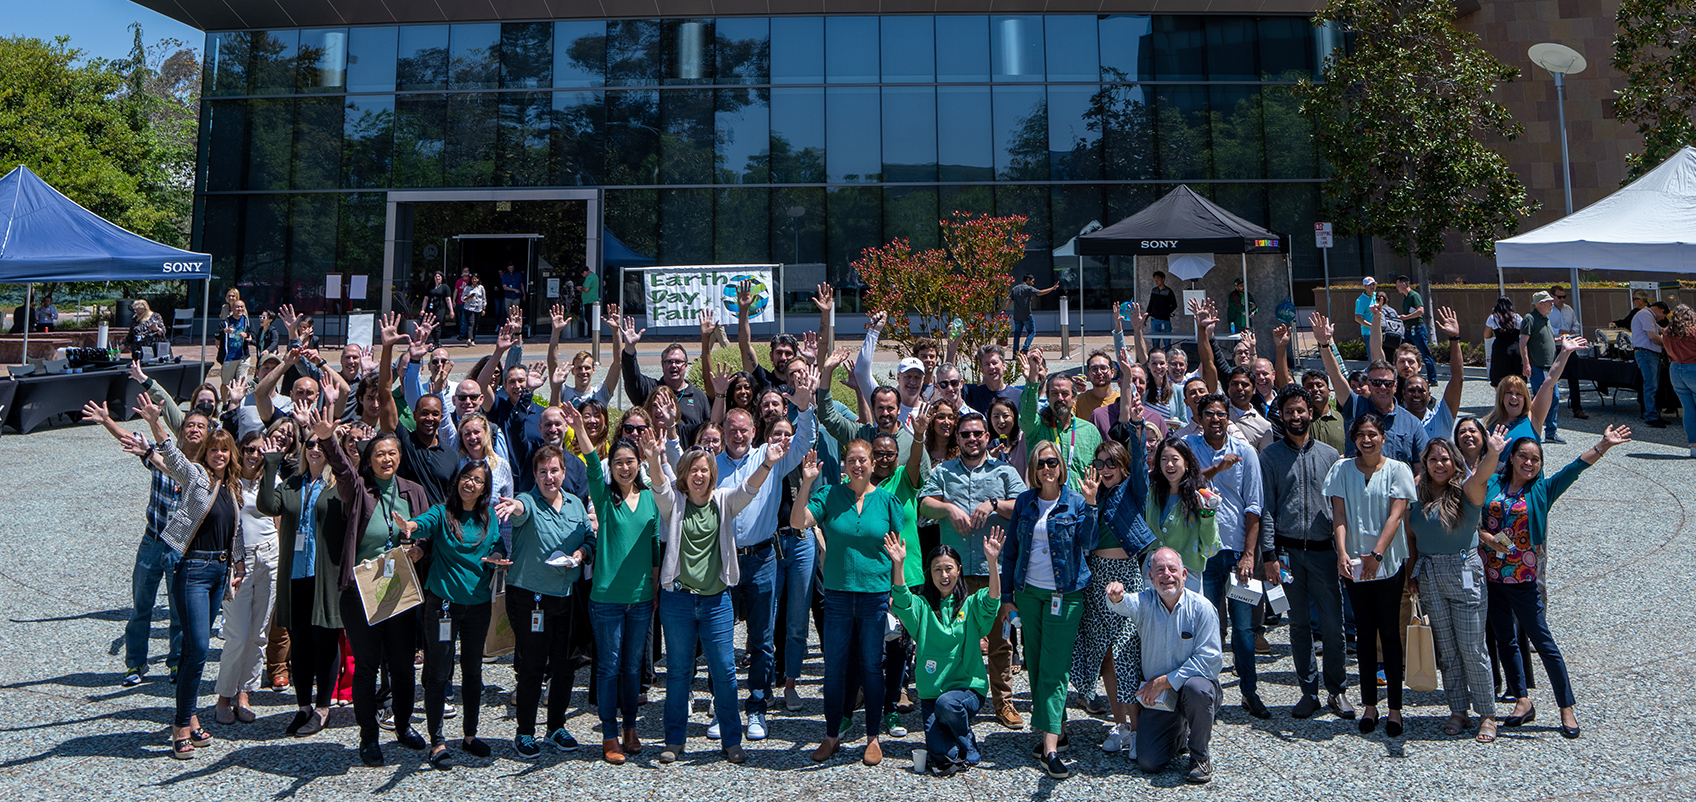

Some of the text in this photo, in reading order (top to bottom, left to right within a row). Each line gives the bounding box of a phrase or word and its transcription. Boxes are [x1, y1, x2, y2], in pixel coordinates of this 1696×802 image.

[1141, 240, 1179, 249] SONY
[162, 262, 203, 273] SONY
[650, 271, 728, 287] Earth
[651, 290, 699, 305] Day
[653, 306, 704, 320] Fair
[1230, 593, 1254, 603] SUMMIT
